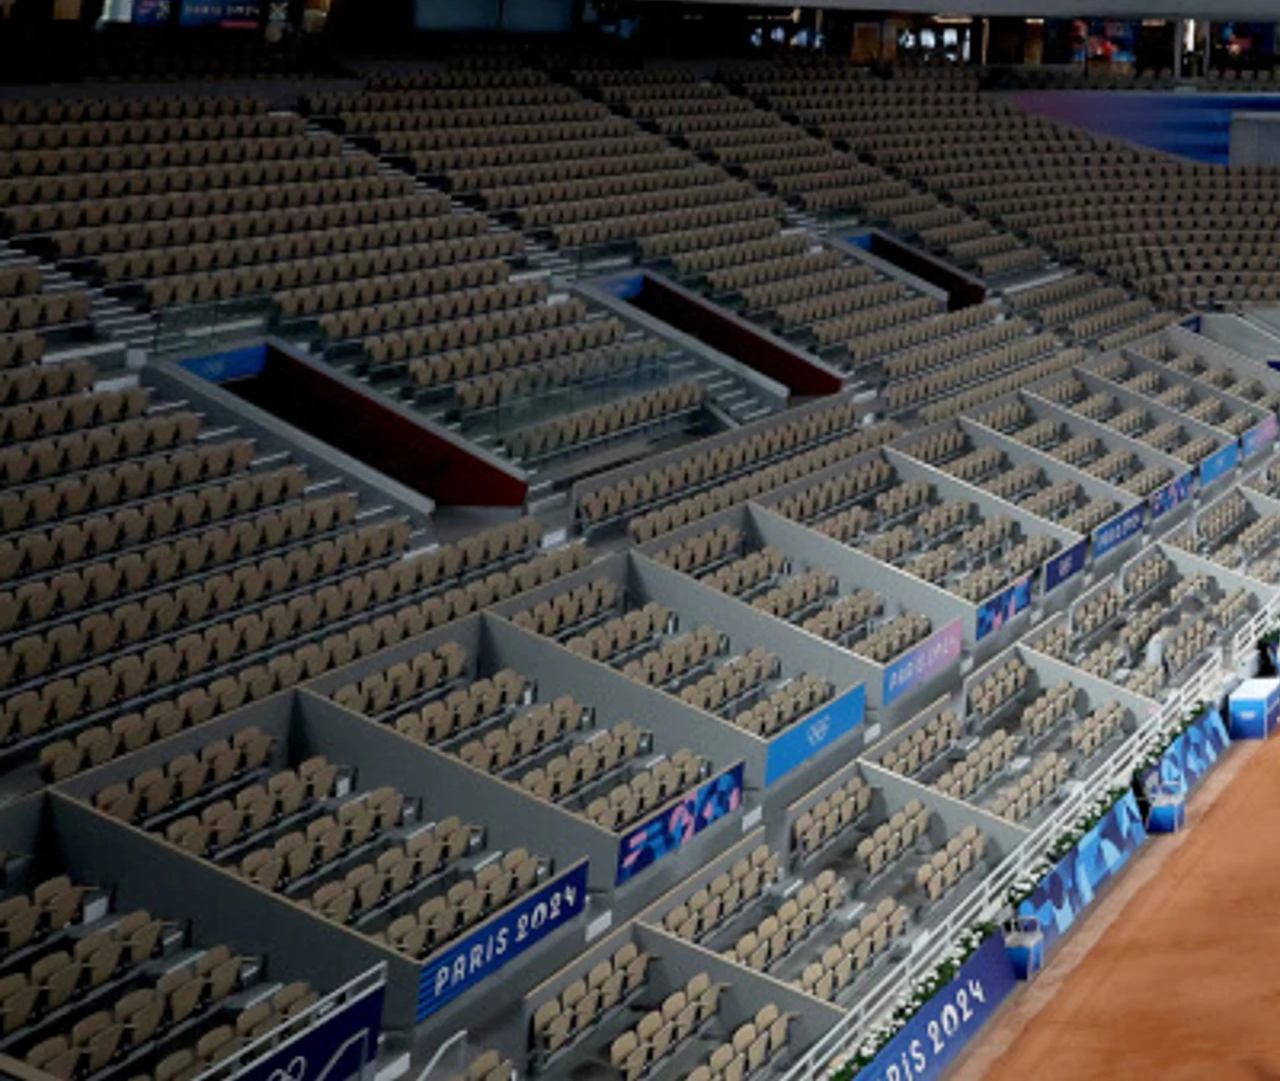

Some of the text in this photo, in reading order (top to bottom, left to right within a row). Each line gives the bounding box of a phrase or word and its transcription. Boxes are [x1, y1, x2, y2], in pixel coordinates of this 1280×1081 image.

[434, 884, 577, 997] PARIS 2024
[927, 979, 986, 1054] 2024
